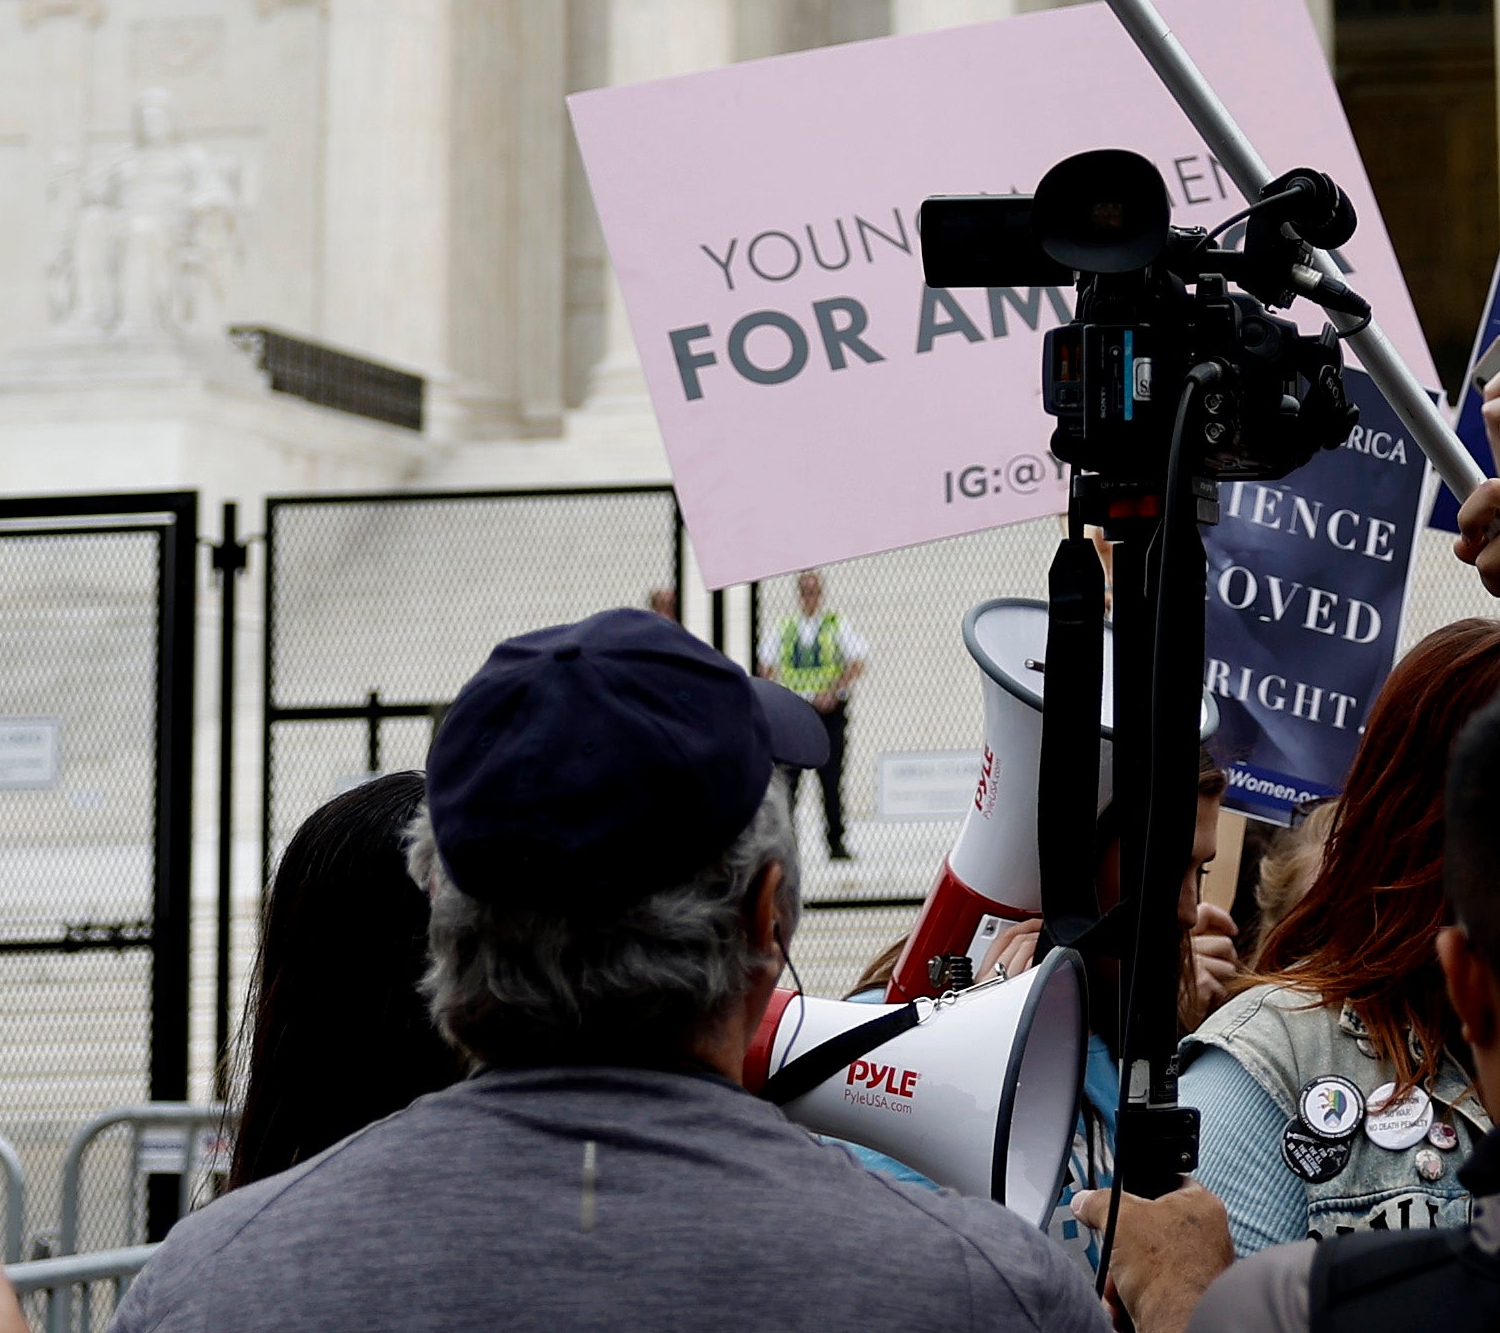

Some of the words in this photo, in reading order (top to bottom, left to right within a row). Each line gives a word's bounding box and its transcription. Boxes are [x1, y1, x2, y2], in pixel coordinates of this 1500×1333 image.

[700, 205, 922, 290] YOUN
[667, 295, 886, 402] FOR
[973, 744, 997, 812] PYLE
[844, 1088, 913, 1116] PyleUSA.com
[846, 1057, 919, 1098] PYLE
